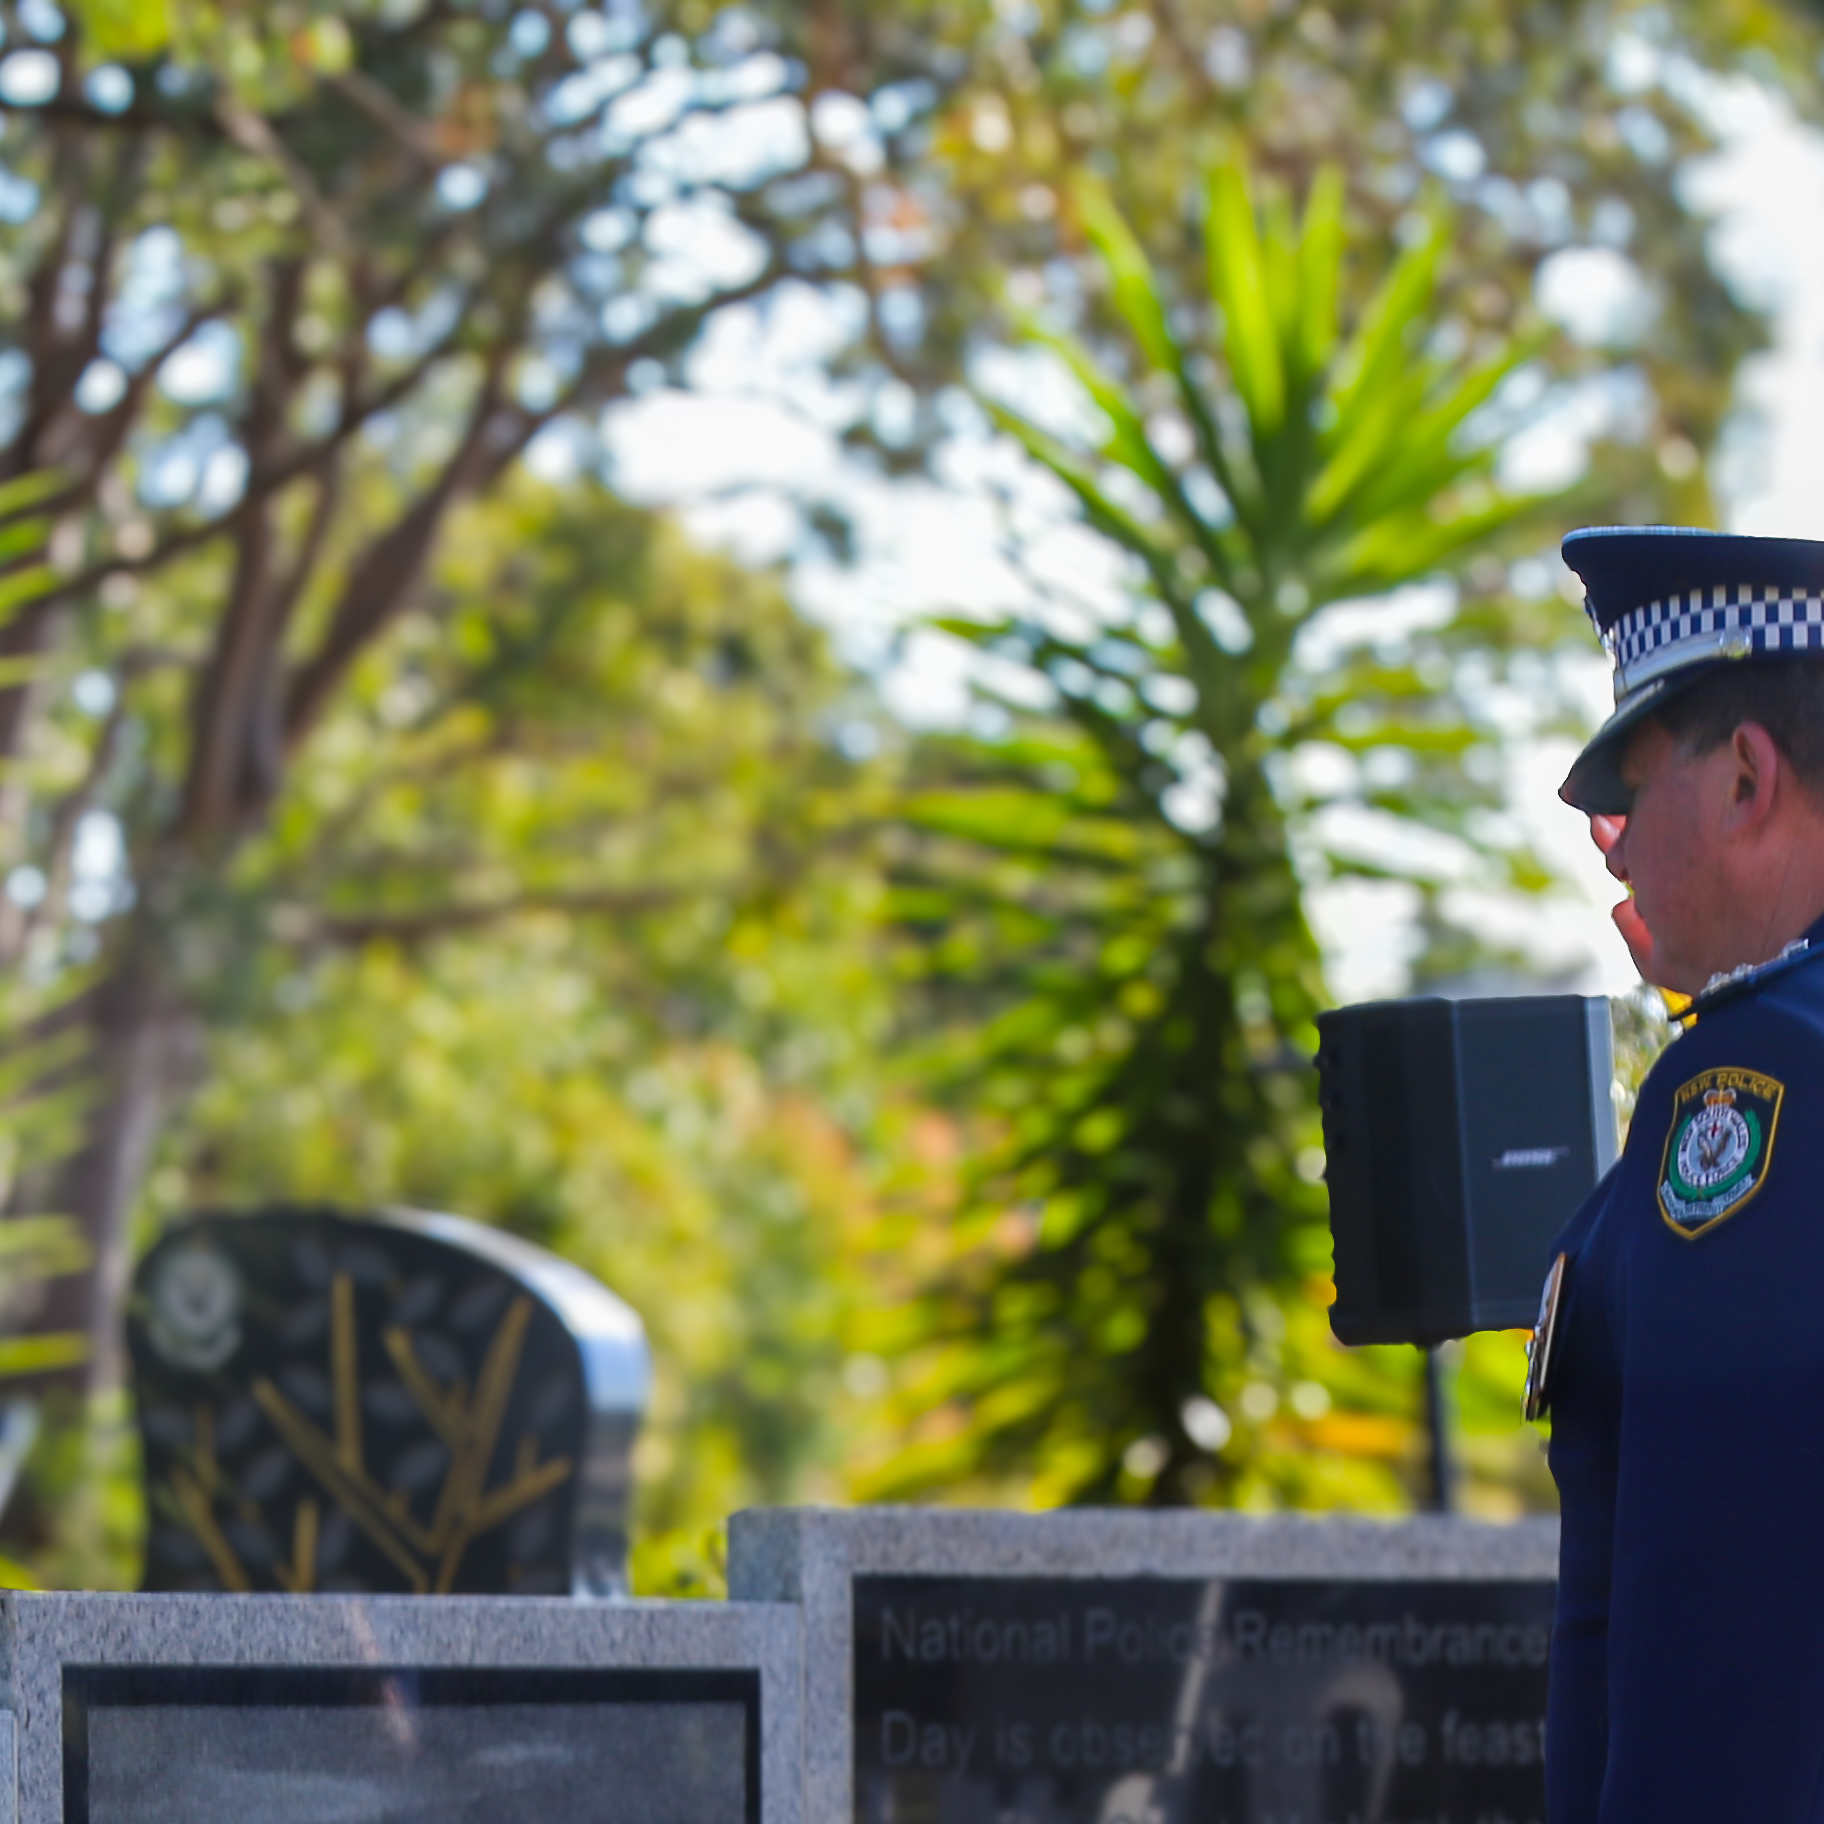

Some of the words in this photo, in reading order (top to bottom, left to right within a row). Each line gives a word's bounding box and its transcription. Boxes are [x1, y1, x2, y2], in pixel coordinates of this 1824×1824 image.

[1717, 1073, 1776, 1102] POLICE
[880, 1607, 1070, 1662] National
[1235, 1610, 1547, 1666] Remembrance
[880, 1710, 977, 1779] Day
[996, 1712, 1033, 1766] is
[1282, 1722, 1341, 1766] on
[1443, 1709, 1546, 1765] feast
